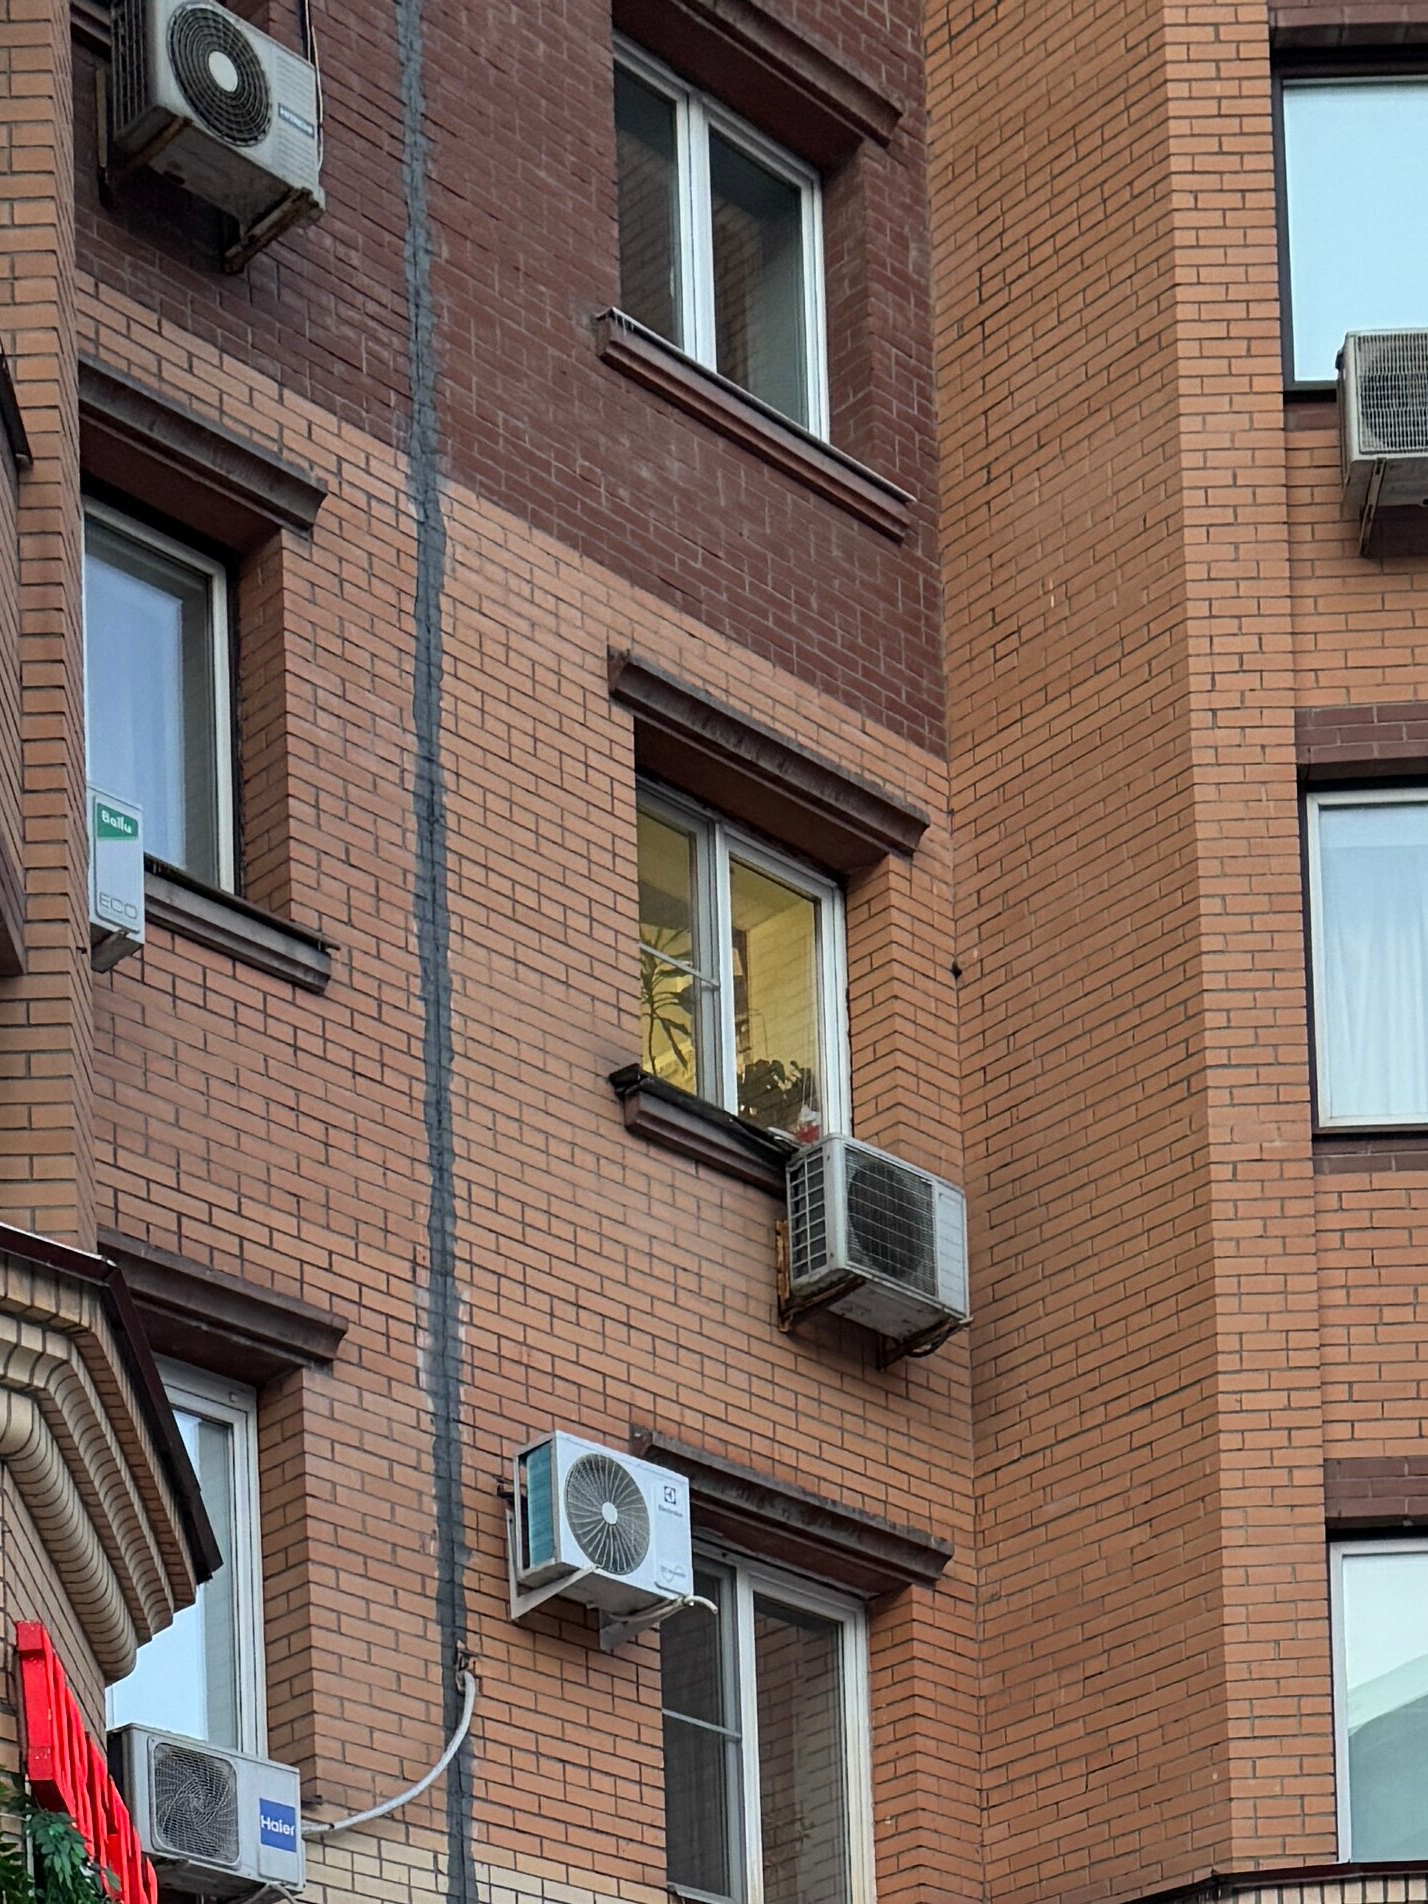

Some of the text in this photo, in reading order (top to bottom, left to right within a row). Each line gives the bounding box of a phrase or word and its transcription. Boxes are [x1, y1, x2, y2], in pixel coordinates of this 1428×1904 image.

[101, 809, 132, 834] Ballu
[99, 891, 137, 919] ECO
[261, 1814, 295, 1836] Haier
